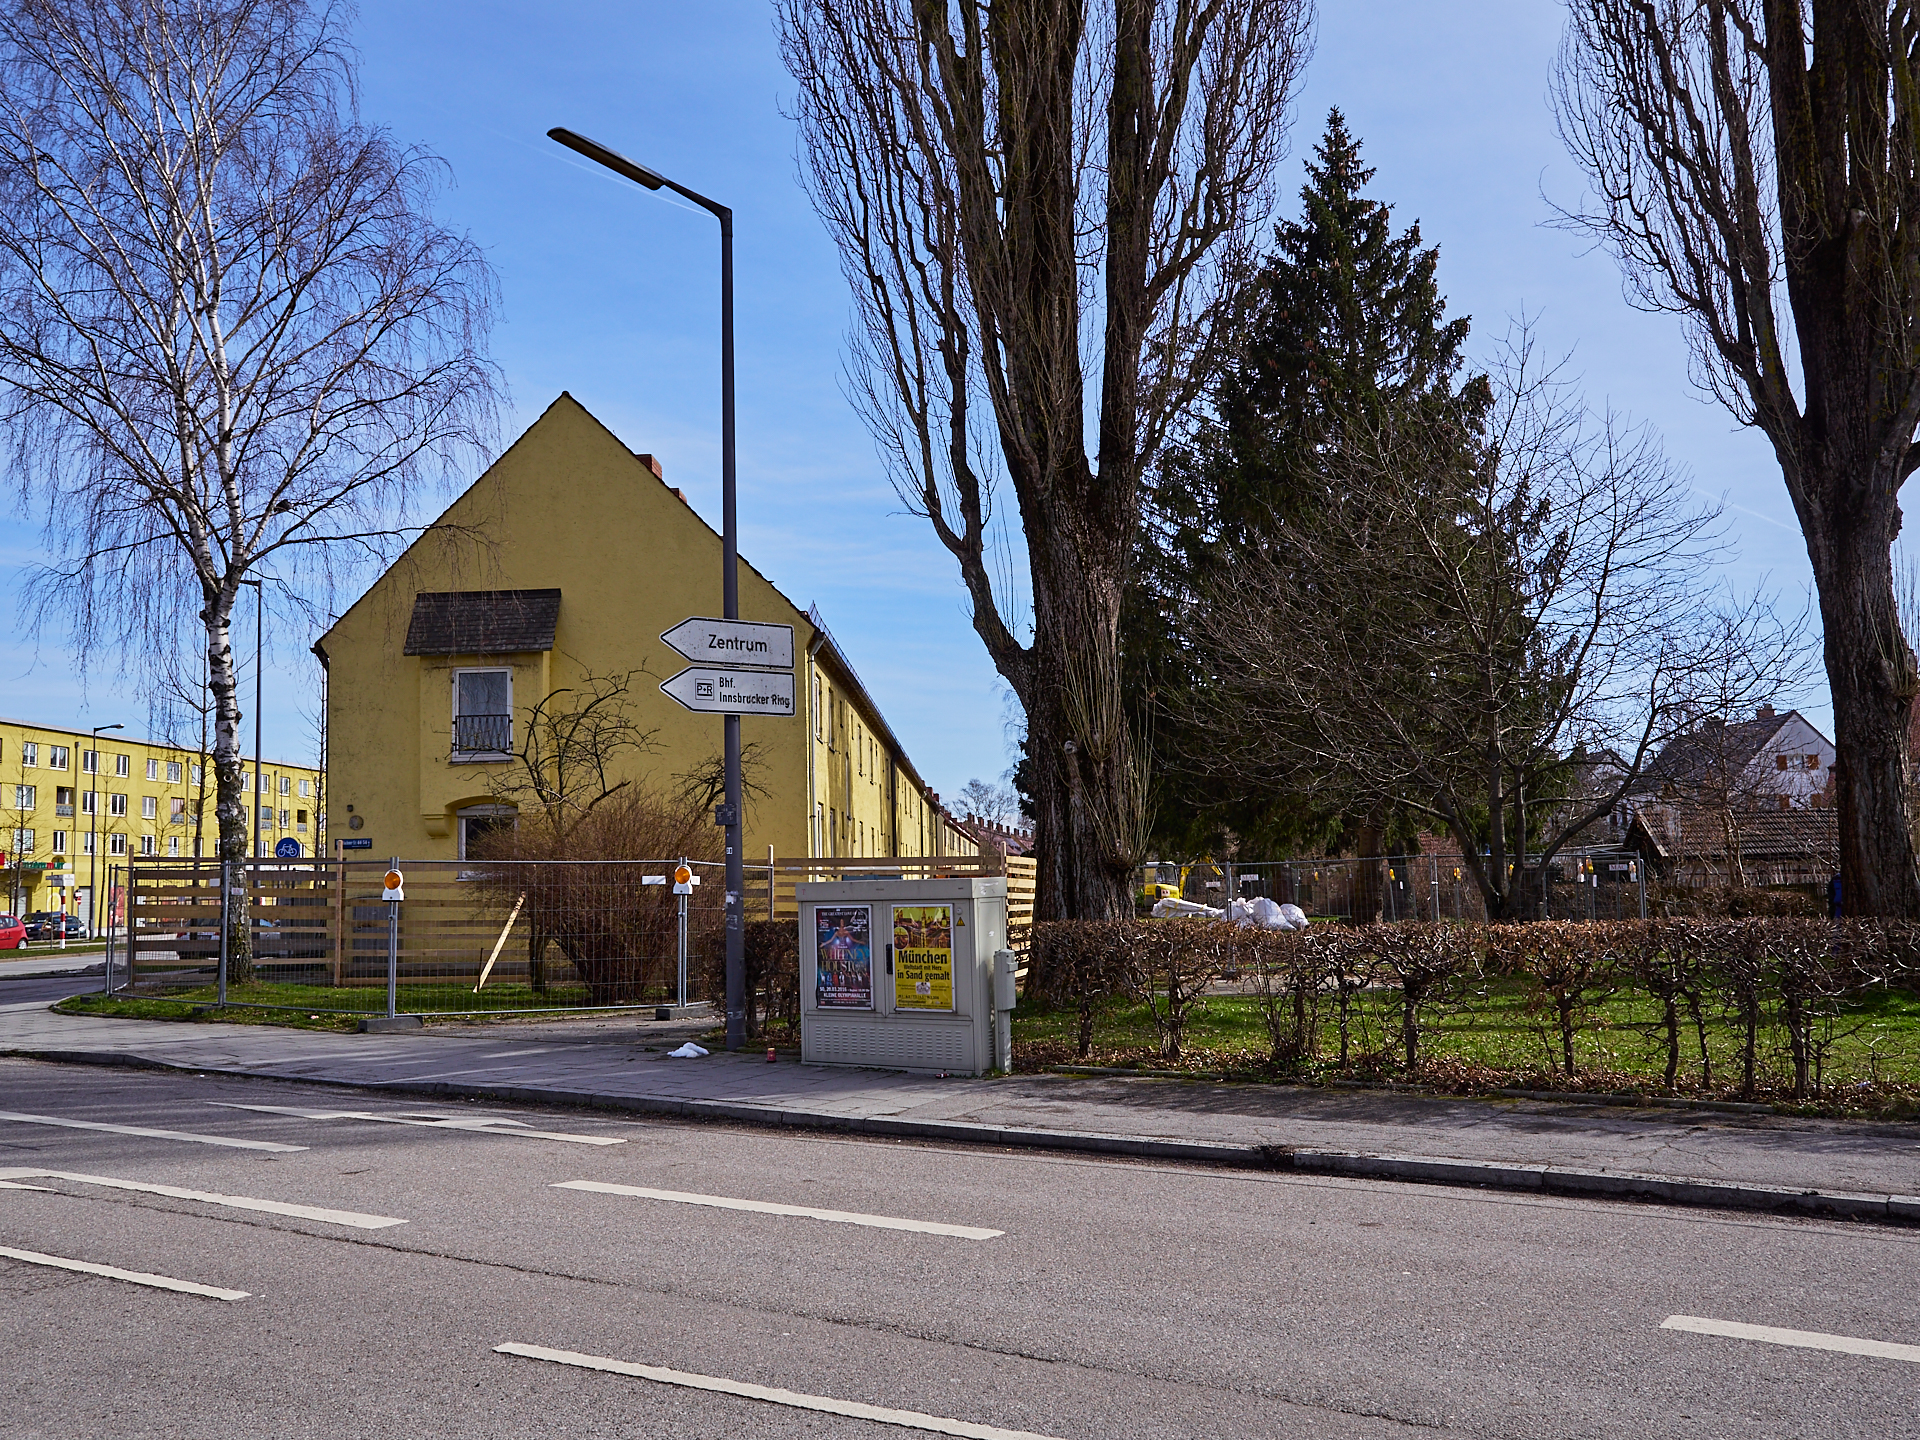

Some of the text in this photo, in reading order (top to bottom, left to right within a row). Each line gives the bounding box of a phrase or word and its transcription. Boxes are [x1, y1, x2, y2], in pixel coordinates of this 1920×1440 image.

[709, 634, 767, 652] Zentrum
[719, 677, 735, 688] Bhf.
[697, 685, 712, 694] P+R
[719, 692, 790, 708] Innsbrucker Ring
[820, 949, 867, 960] WHITNEY
[898, 950, 948, 965] München
[821, 960, 867, 972] HOUSTON
[897, 970, 950, 982] in Sand gemalt
